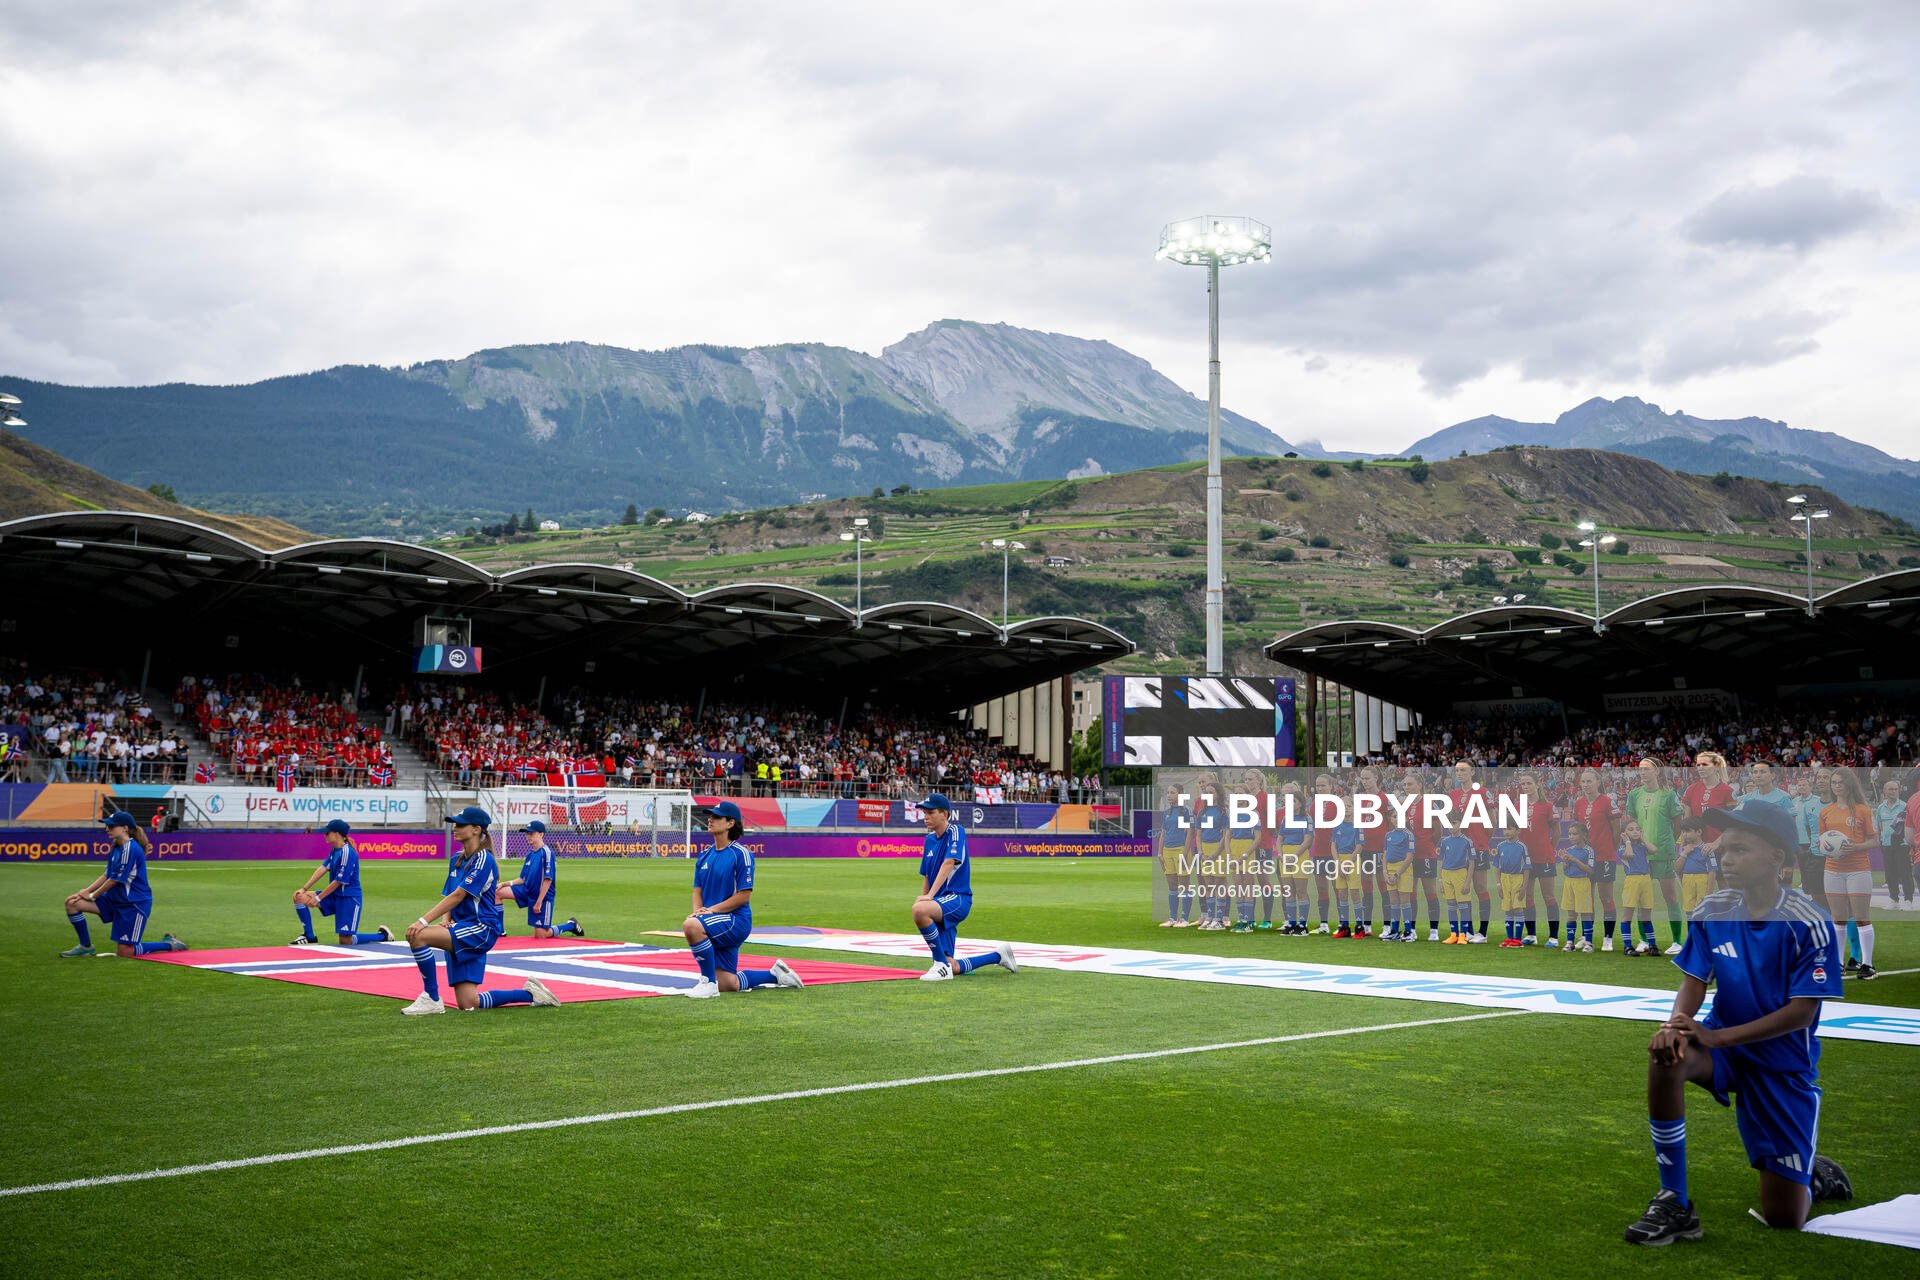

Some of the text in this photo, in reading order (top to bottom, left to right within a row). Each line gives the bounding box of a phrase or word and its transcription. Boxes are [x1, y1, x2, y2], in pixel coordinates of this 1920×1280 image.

[246, 798, 409, 813] UEFA WOMEN'S EURO
[159, 841, 193, 858] part
[358, 842, 438, 855] #WePlayStrong
[557, 841, 581, 854] Visit
[586, 841, 698, 857] weplaystrong.com
[1004, 842, 1150, 856] Visit weplaystrong.com to take part
